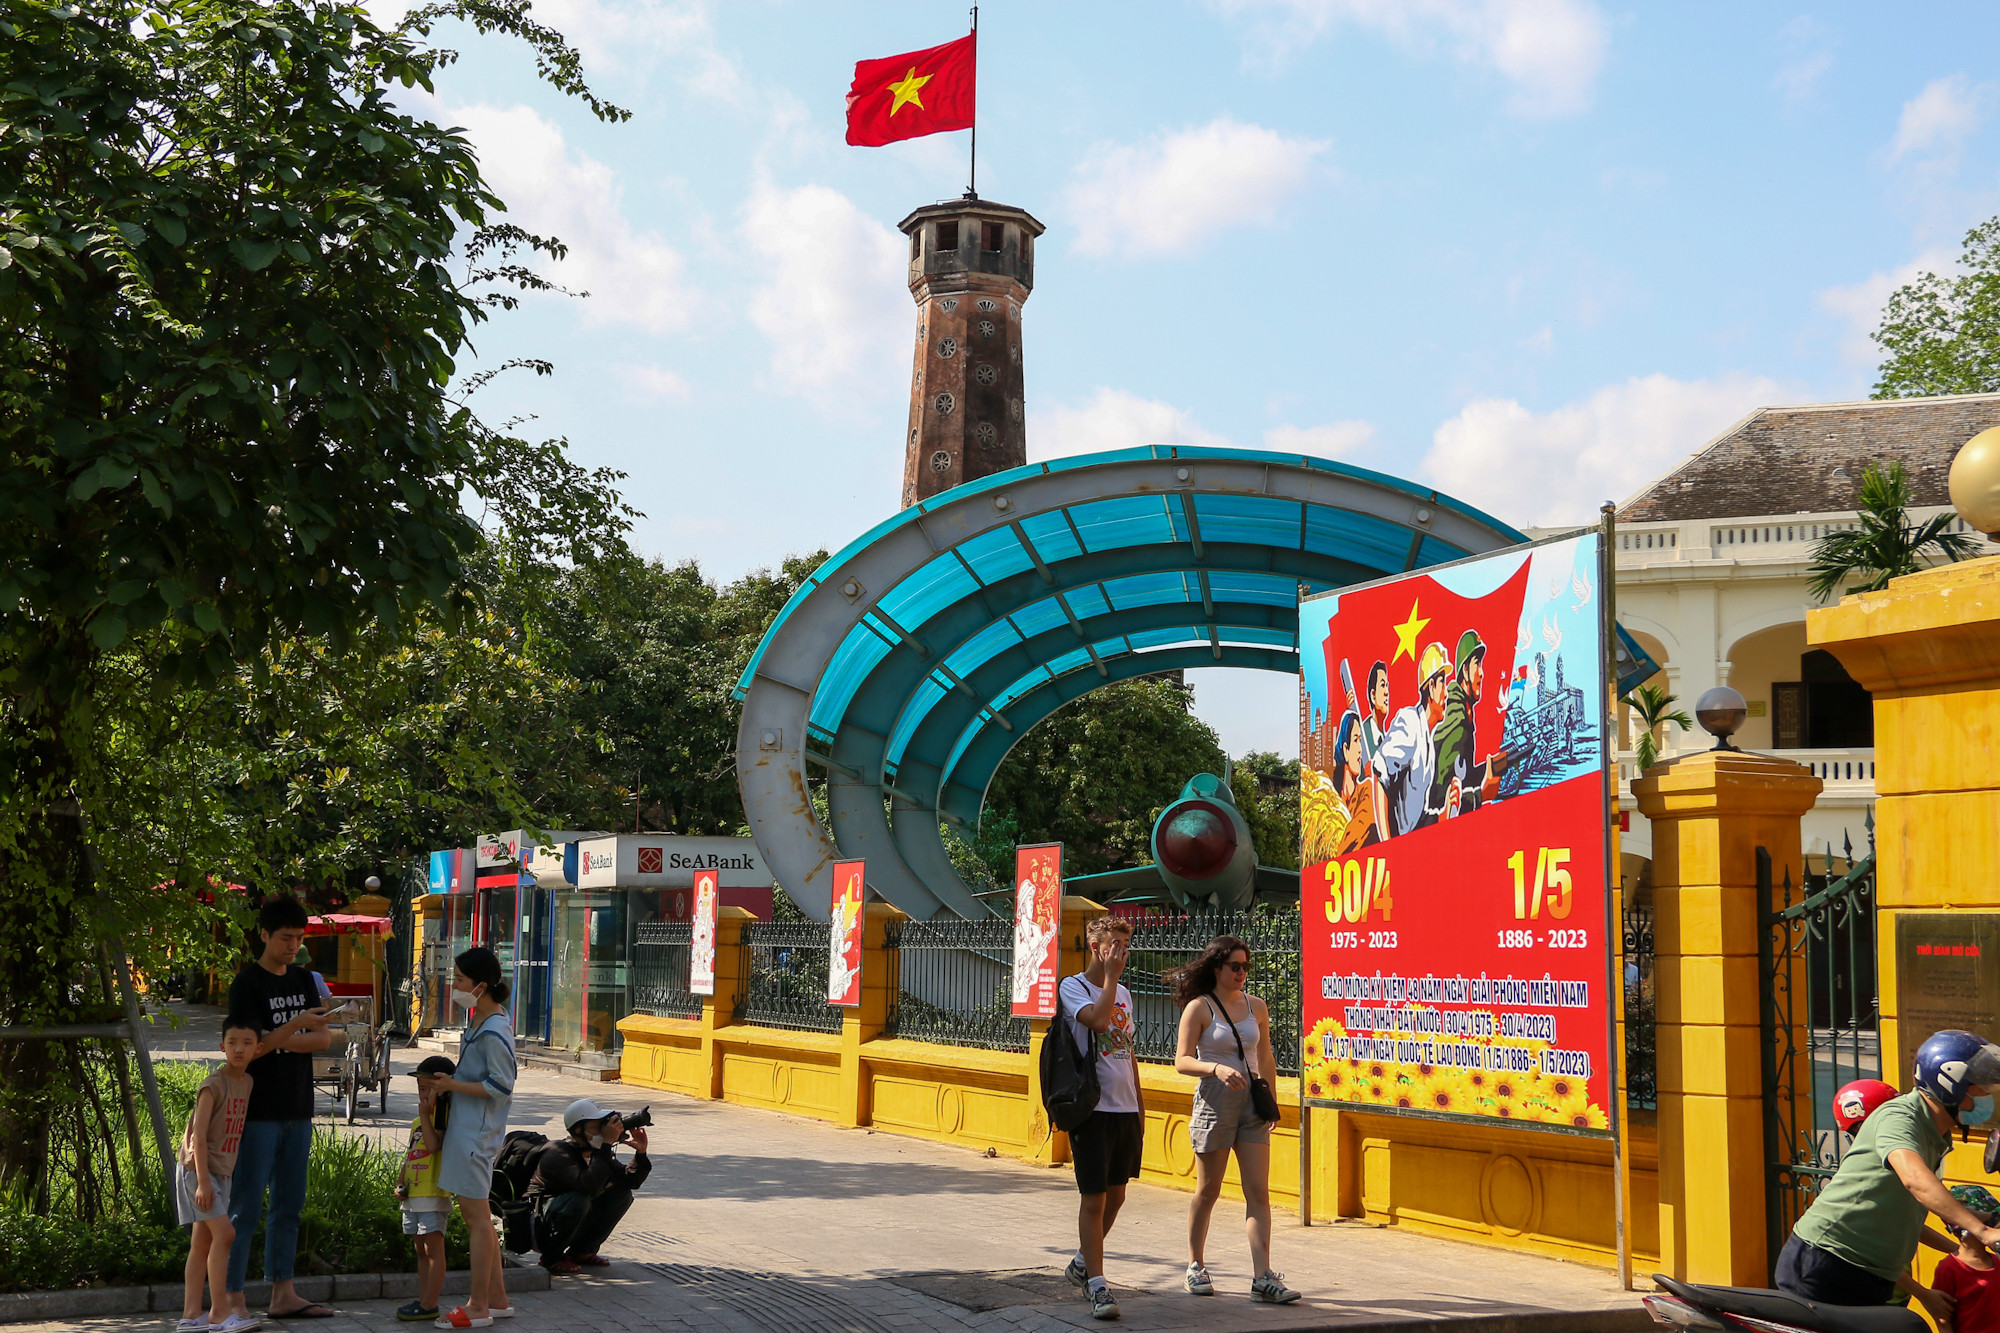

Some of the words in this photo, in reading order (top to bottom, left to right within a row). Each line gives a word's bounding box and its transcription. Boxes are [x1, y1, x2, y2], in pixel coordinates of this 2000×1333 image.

[590, 853, 613, 870] SeABank
[669, 853, 755, 870] SeABank
[1324, 857, 1393, 924] 30/4
[1507, 847, 1573, 920] 1/5
[1330, 931, 1357, 949] 1975
[1368, 931, 1398, 949] 2023
[1497, 930, 1533, 949] 1886
[1548, 929, 1587, 949] 2023
[1322, 972, 1343, 999] CHÀO
[1344, 972, 1369, 1000] MỪNG
[1370, 970, 1381, 1000] KỶ
[1383, 973, 1406, 1005] NIỆM
[1407, 978, 1419, 1001] 48
[1420, 973, 1442, 1002] NĂM
[1443, 974, 1468, 1003] NGÀY
[1471, 971, 1491, 1004] GIẢI
[1492, 974, 1528, 1005] PHÓNG
[1530, 972, 1559, 1006] MIỀN
[1560, 981, 1588, 1008] NAM
[1344, 1000, 1372, 1030] THỐNG
[1372, 1001, 1395, 1031] NHẤT
[1397, 1001, 1414, 1032] ĐẤT
[1415, 1005, 1441, 1034] NƯỚC
[1443, 1010, 1492, 1037] (30/4/1975
[1501, 1013, 1556, 1044] 30/4/2023)
[1323, 1031, 1334, 1058] VÀ
[1335, 1037, 1349, 1059] 137
[1350, 1033, 1371, 1060] NĂM
[1372, 1034, 1395, 1062] NGÀY
[1397, 1033, 1421, 1065] QUỐC
[1421, 1036, 1434, 1065] TẾ
[1435, 1042, 1453, 1066] LAO
[1454, 1039, 1480, 1072] ĐỘNG
[1483, 1045, 1529, 1072] (1/5/1886
[1539, 1050, 1590, 1080] 1/5/2023)
